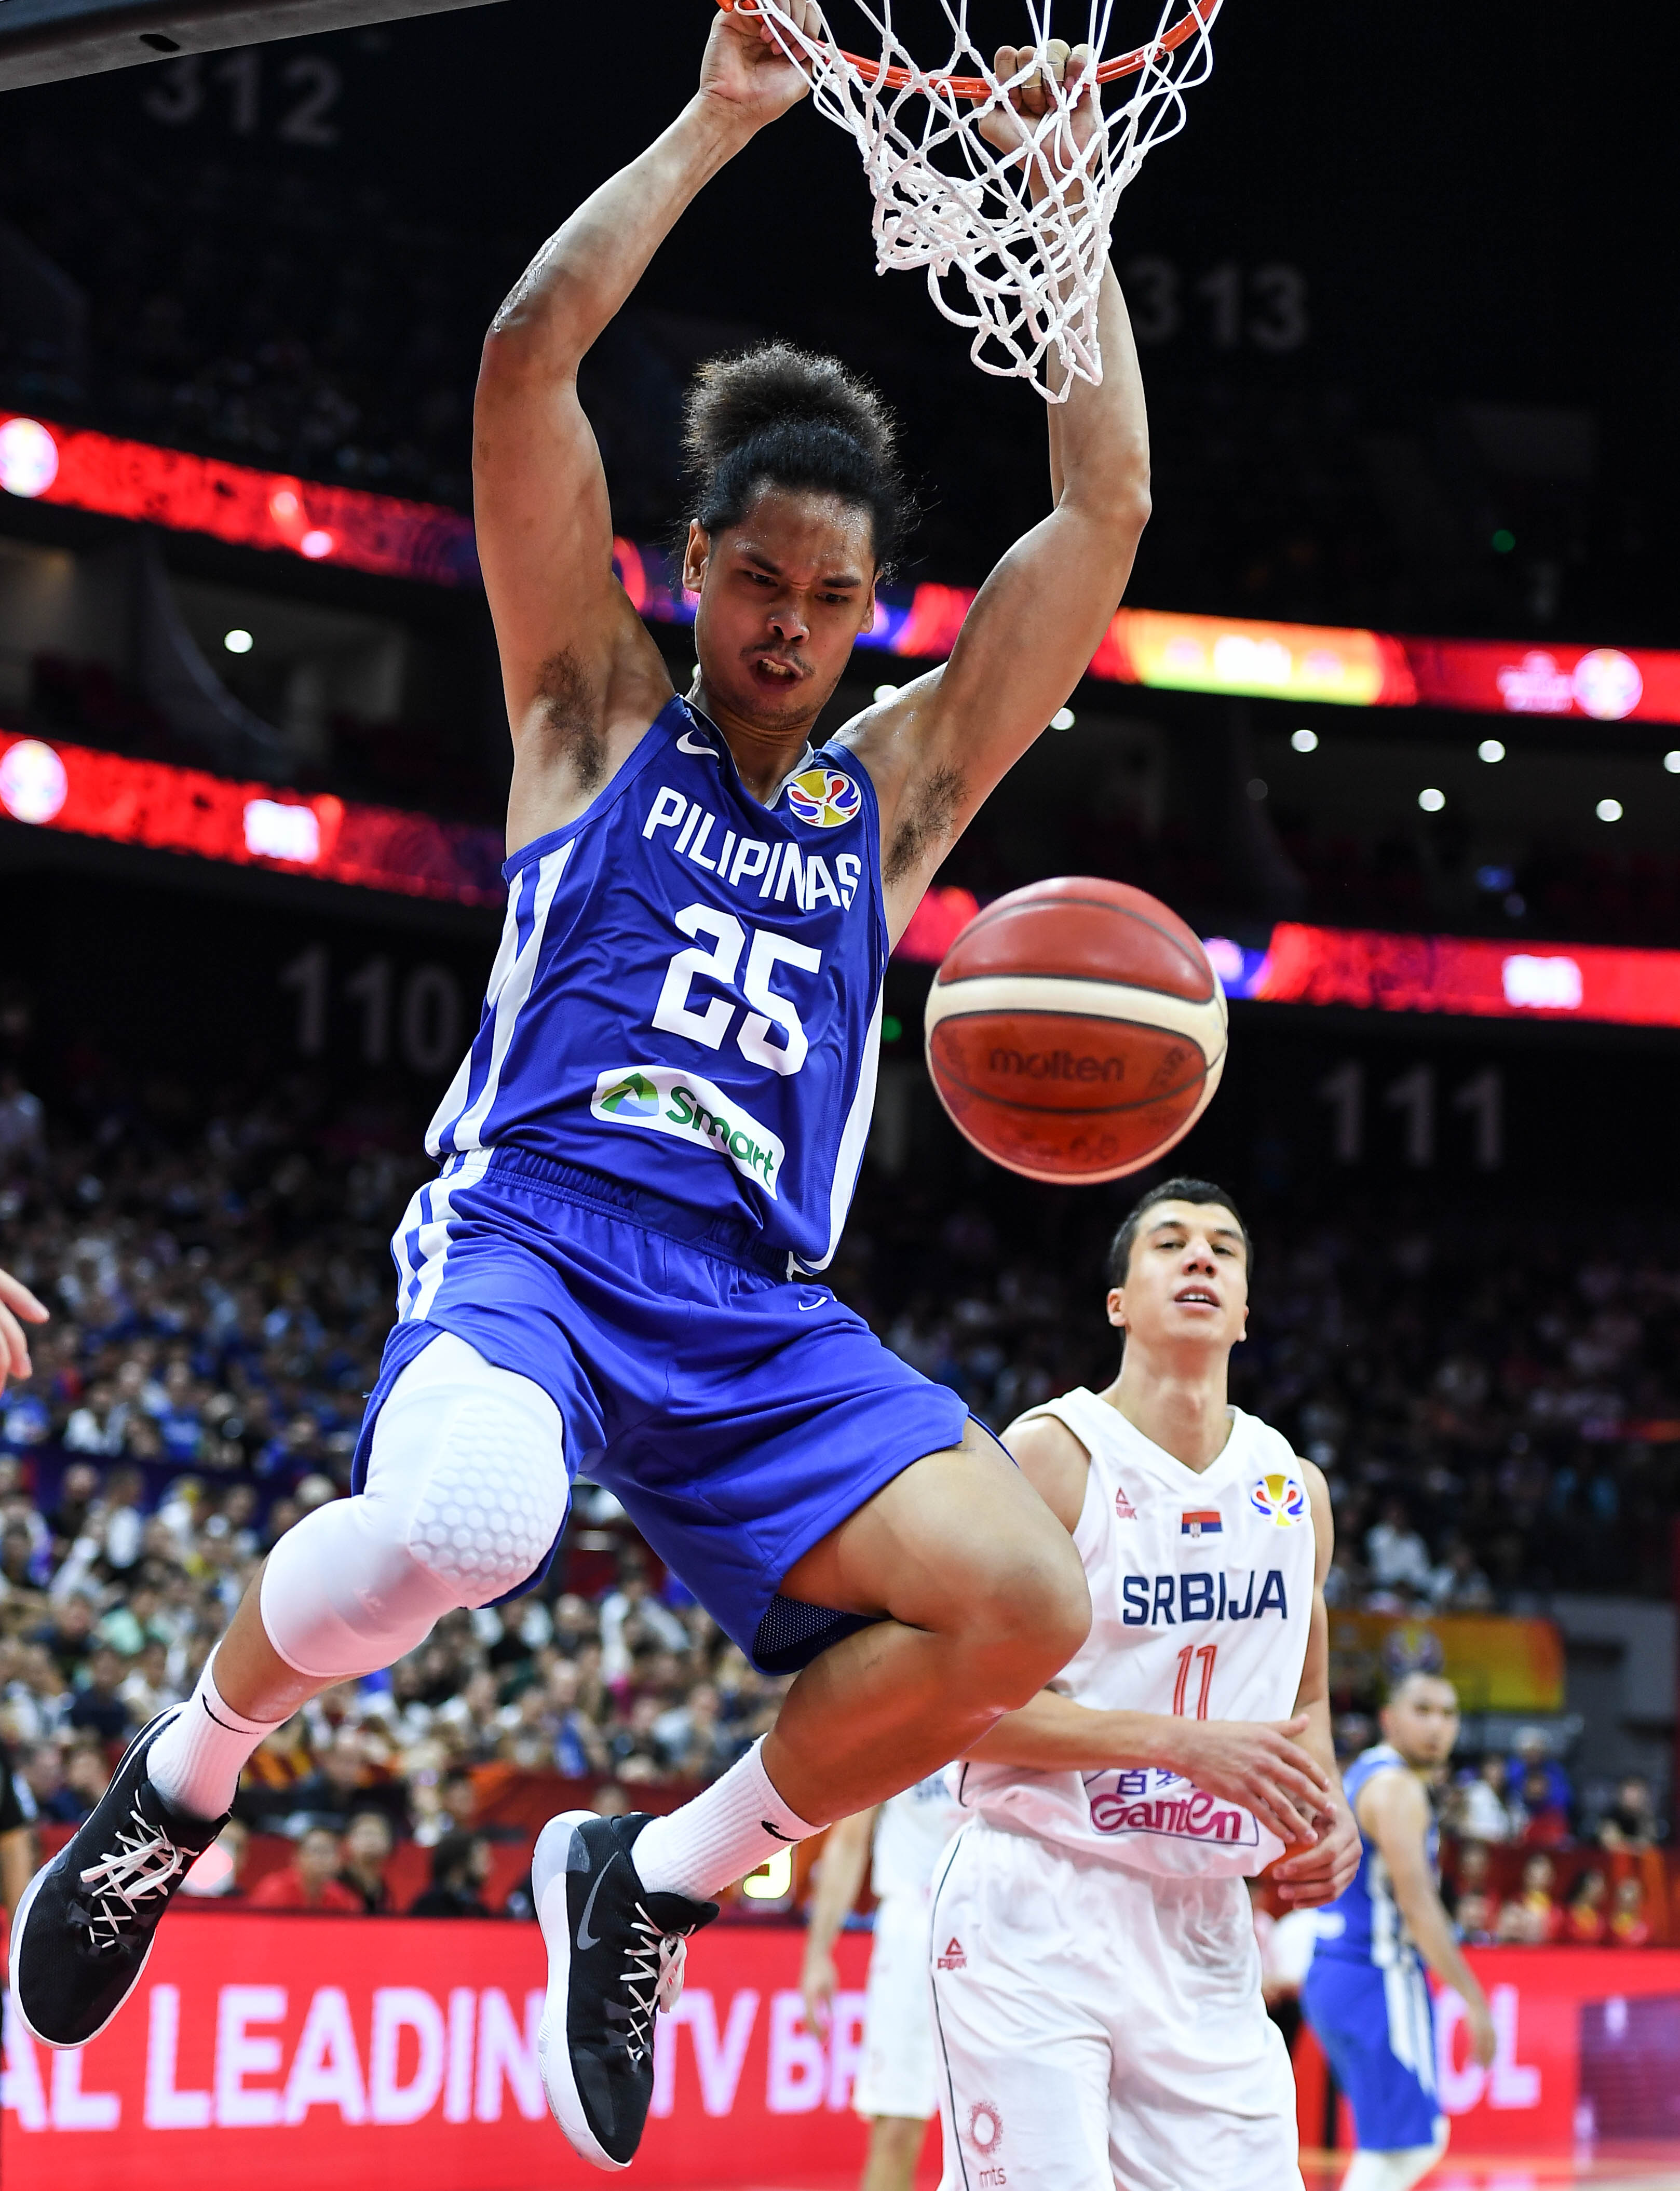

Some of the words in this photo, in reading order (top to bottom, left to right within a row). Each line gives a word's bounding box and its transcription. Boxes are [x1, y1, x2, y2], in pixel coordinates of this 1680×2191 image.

[143, 50, 344, 145] 312
[1123, 254, 1310, 352] 313
[642, 786, 862, 912] PILIPINAS
[278, 941, 466, 1077] 110
[652, 902, 822, 1076] 25
[989, 1048, 1126, 1082] molten
[1317, 1056, 1505, 1172] 111
[665, 1085, 775, 1191] Smart
[1122, 1570, 1288, 1625] SRBIJA
[1173, 1644, 1218, 1721] 11
[144, 1984, 543, 2129] LEADIN
[980, 2165, 1007, 2189] mts
